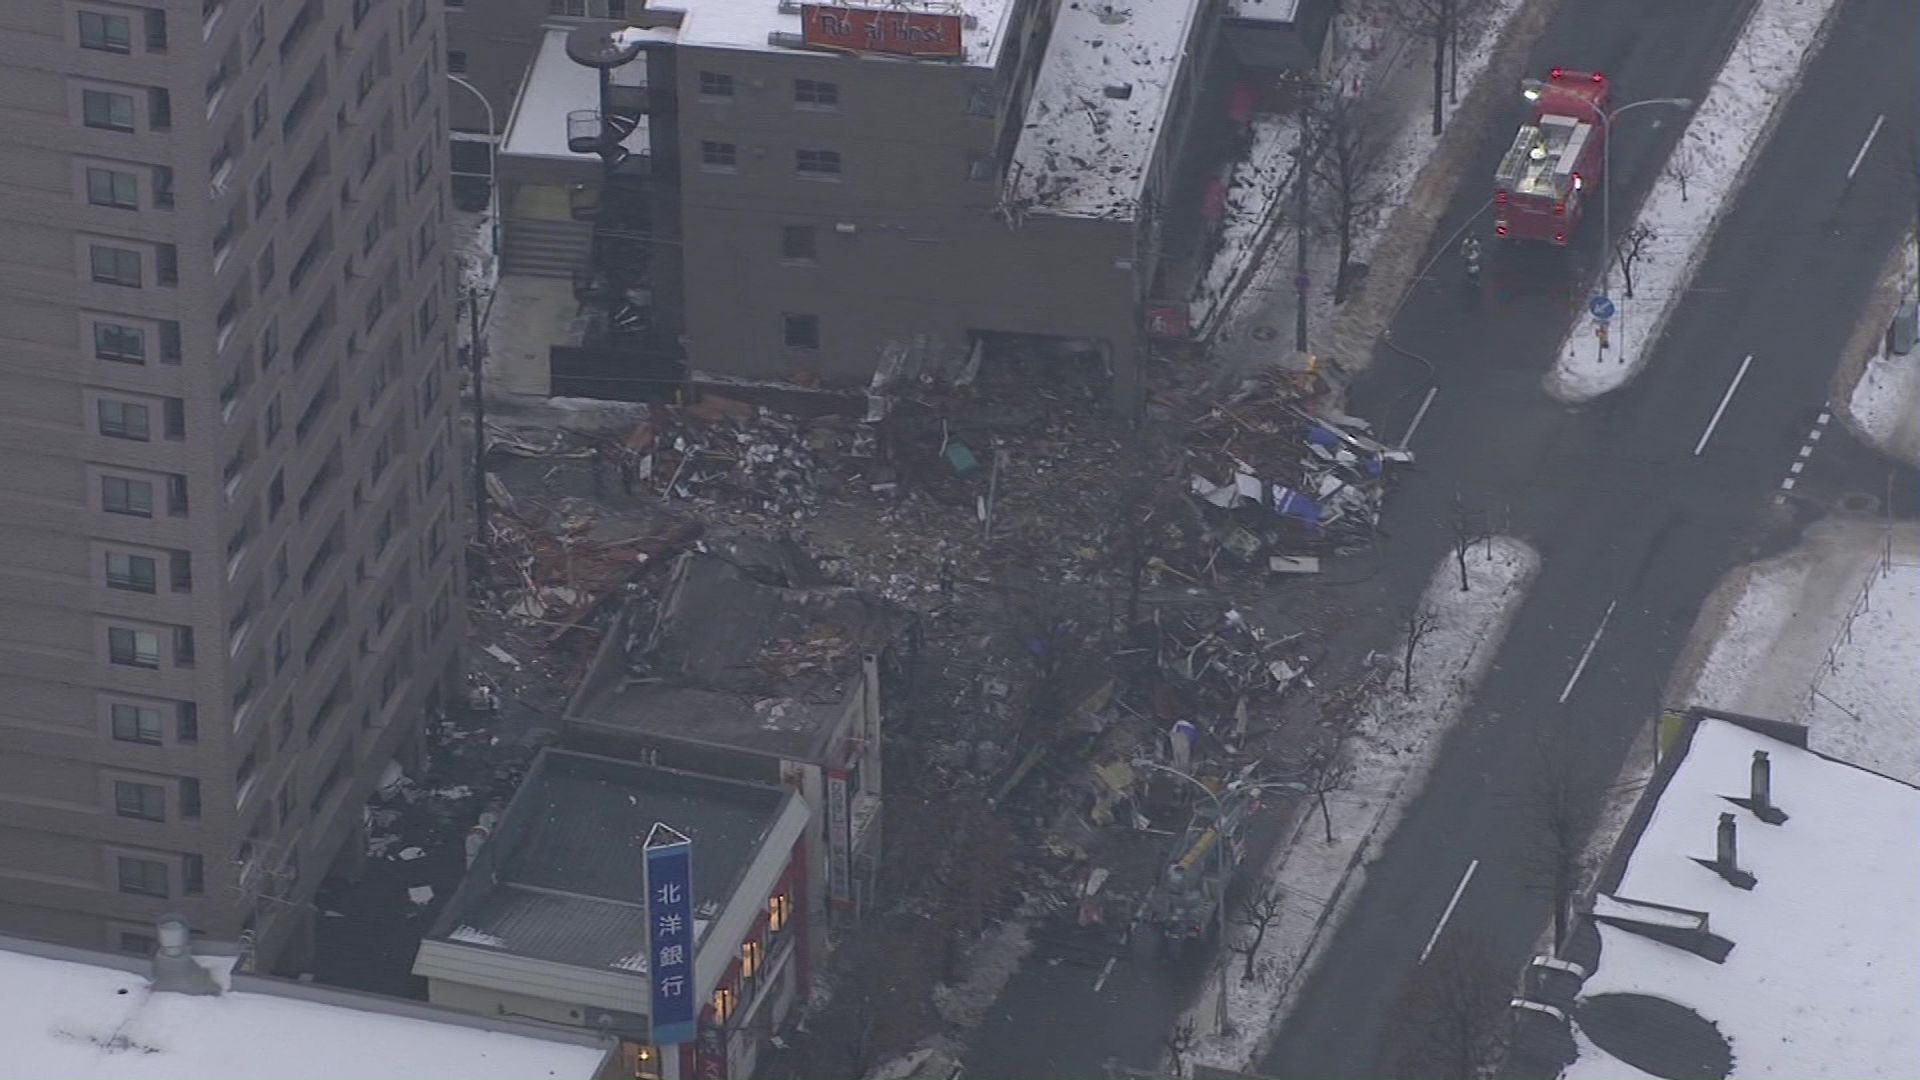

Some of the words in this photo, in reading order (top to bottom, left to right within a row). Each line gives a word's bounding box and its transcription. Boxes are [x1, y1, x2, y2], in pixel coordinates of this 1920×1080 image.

[822, 15, 884, 41] Roal
[657, 883, 684, 998] 北洋銀行
